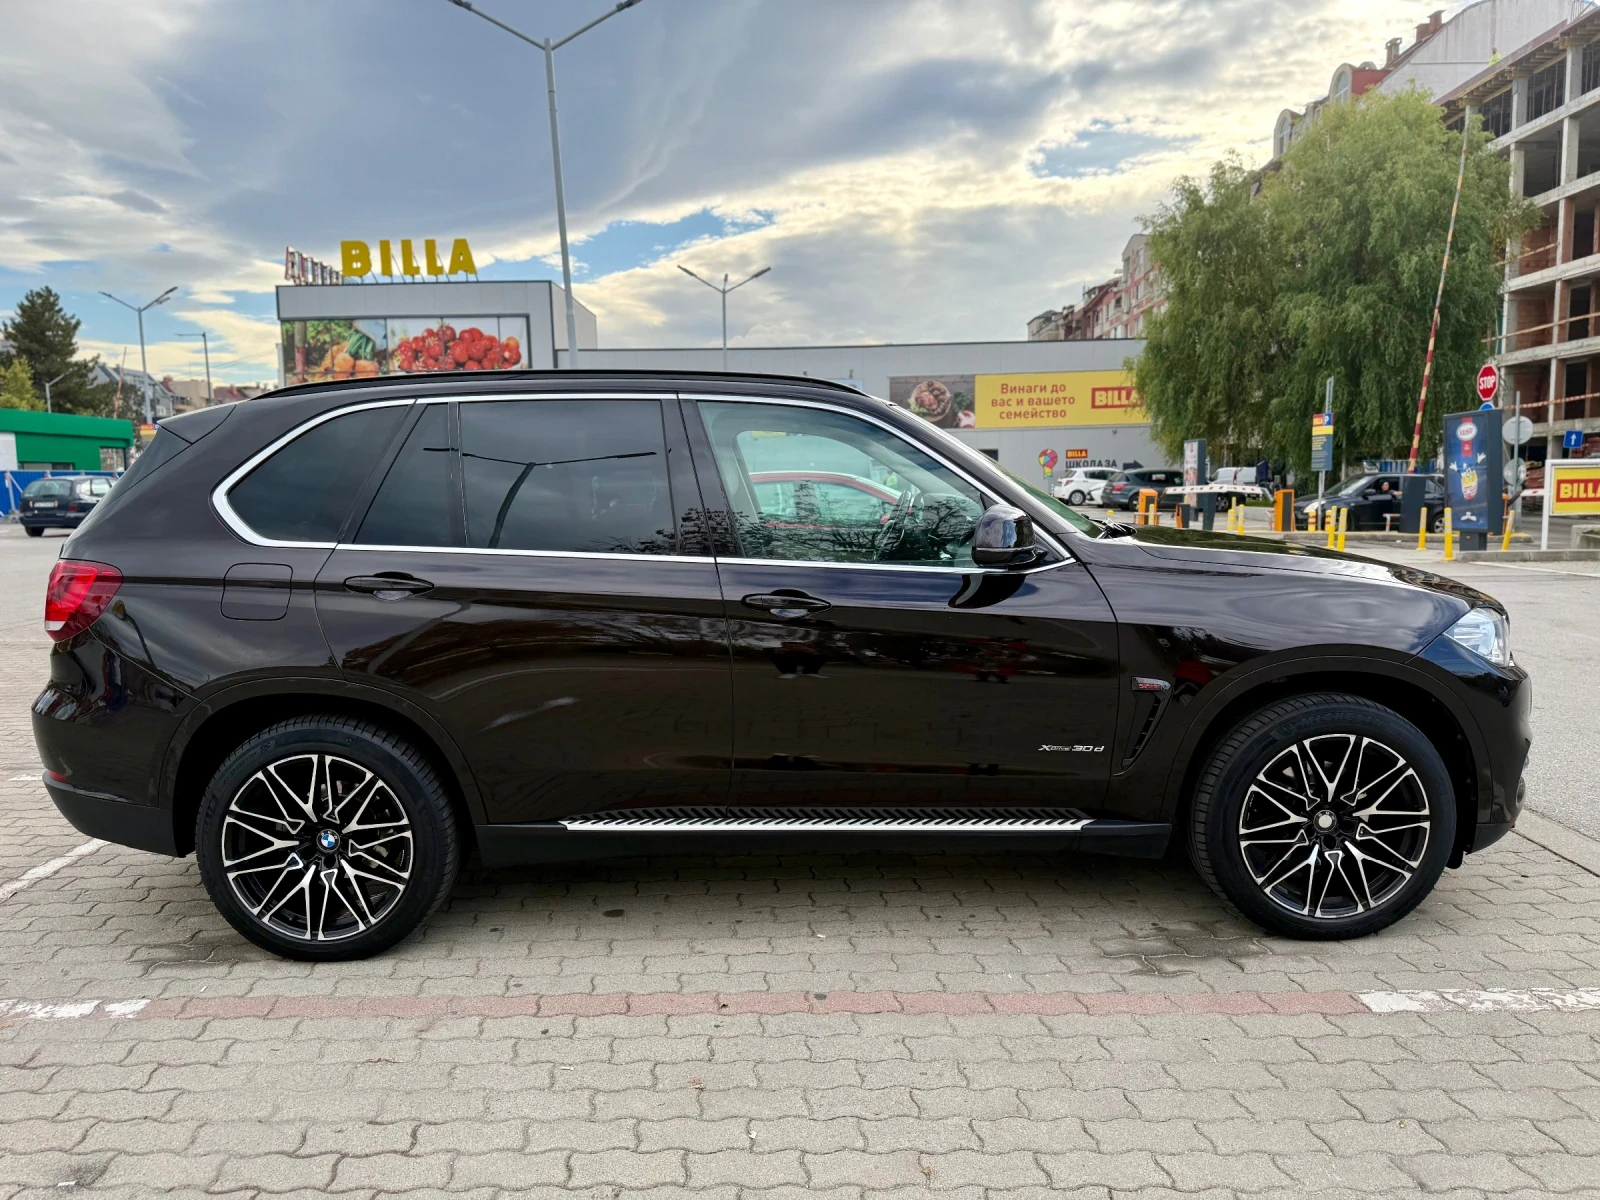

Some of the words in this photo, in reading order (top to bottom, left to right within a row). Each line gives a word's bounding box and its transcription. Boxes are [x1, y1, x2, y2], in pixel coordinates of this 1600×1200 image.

[340, 238, 478, 277] BILLA
[1479, 375, 1496, 390] STOP
[1000, 383, 1047, 395] Винаги
[1050, 384, 1066, 396] до
[991, 397, 1013, 407] вас
[1016, 396, 1024, 406] и
[1027, 395, 1075, 406] вашето
[1095, 389, 1141, 407] BILLA
[999, 407, 1067, 420] семейство
[1065, 460, 1102, 468] ШКОЛА
